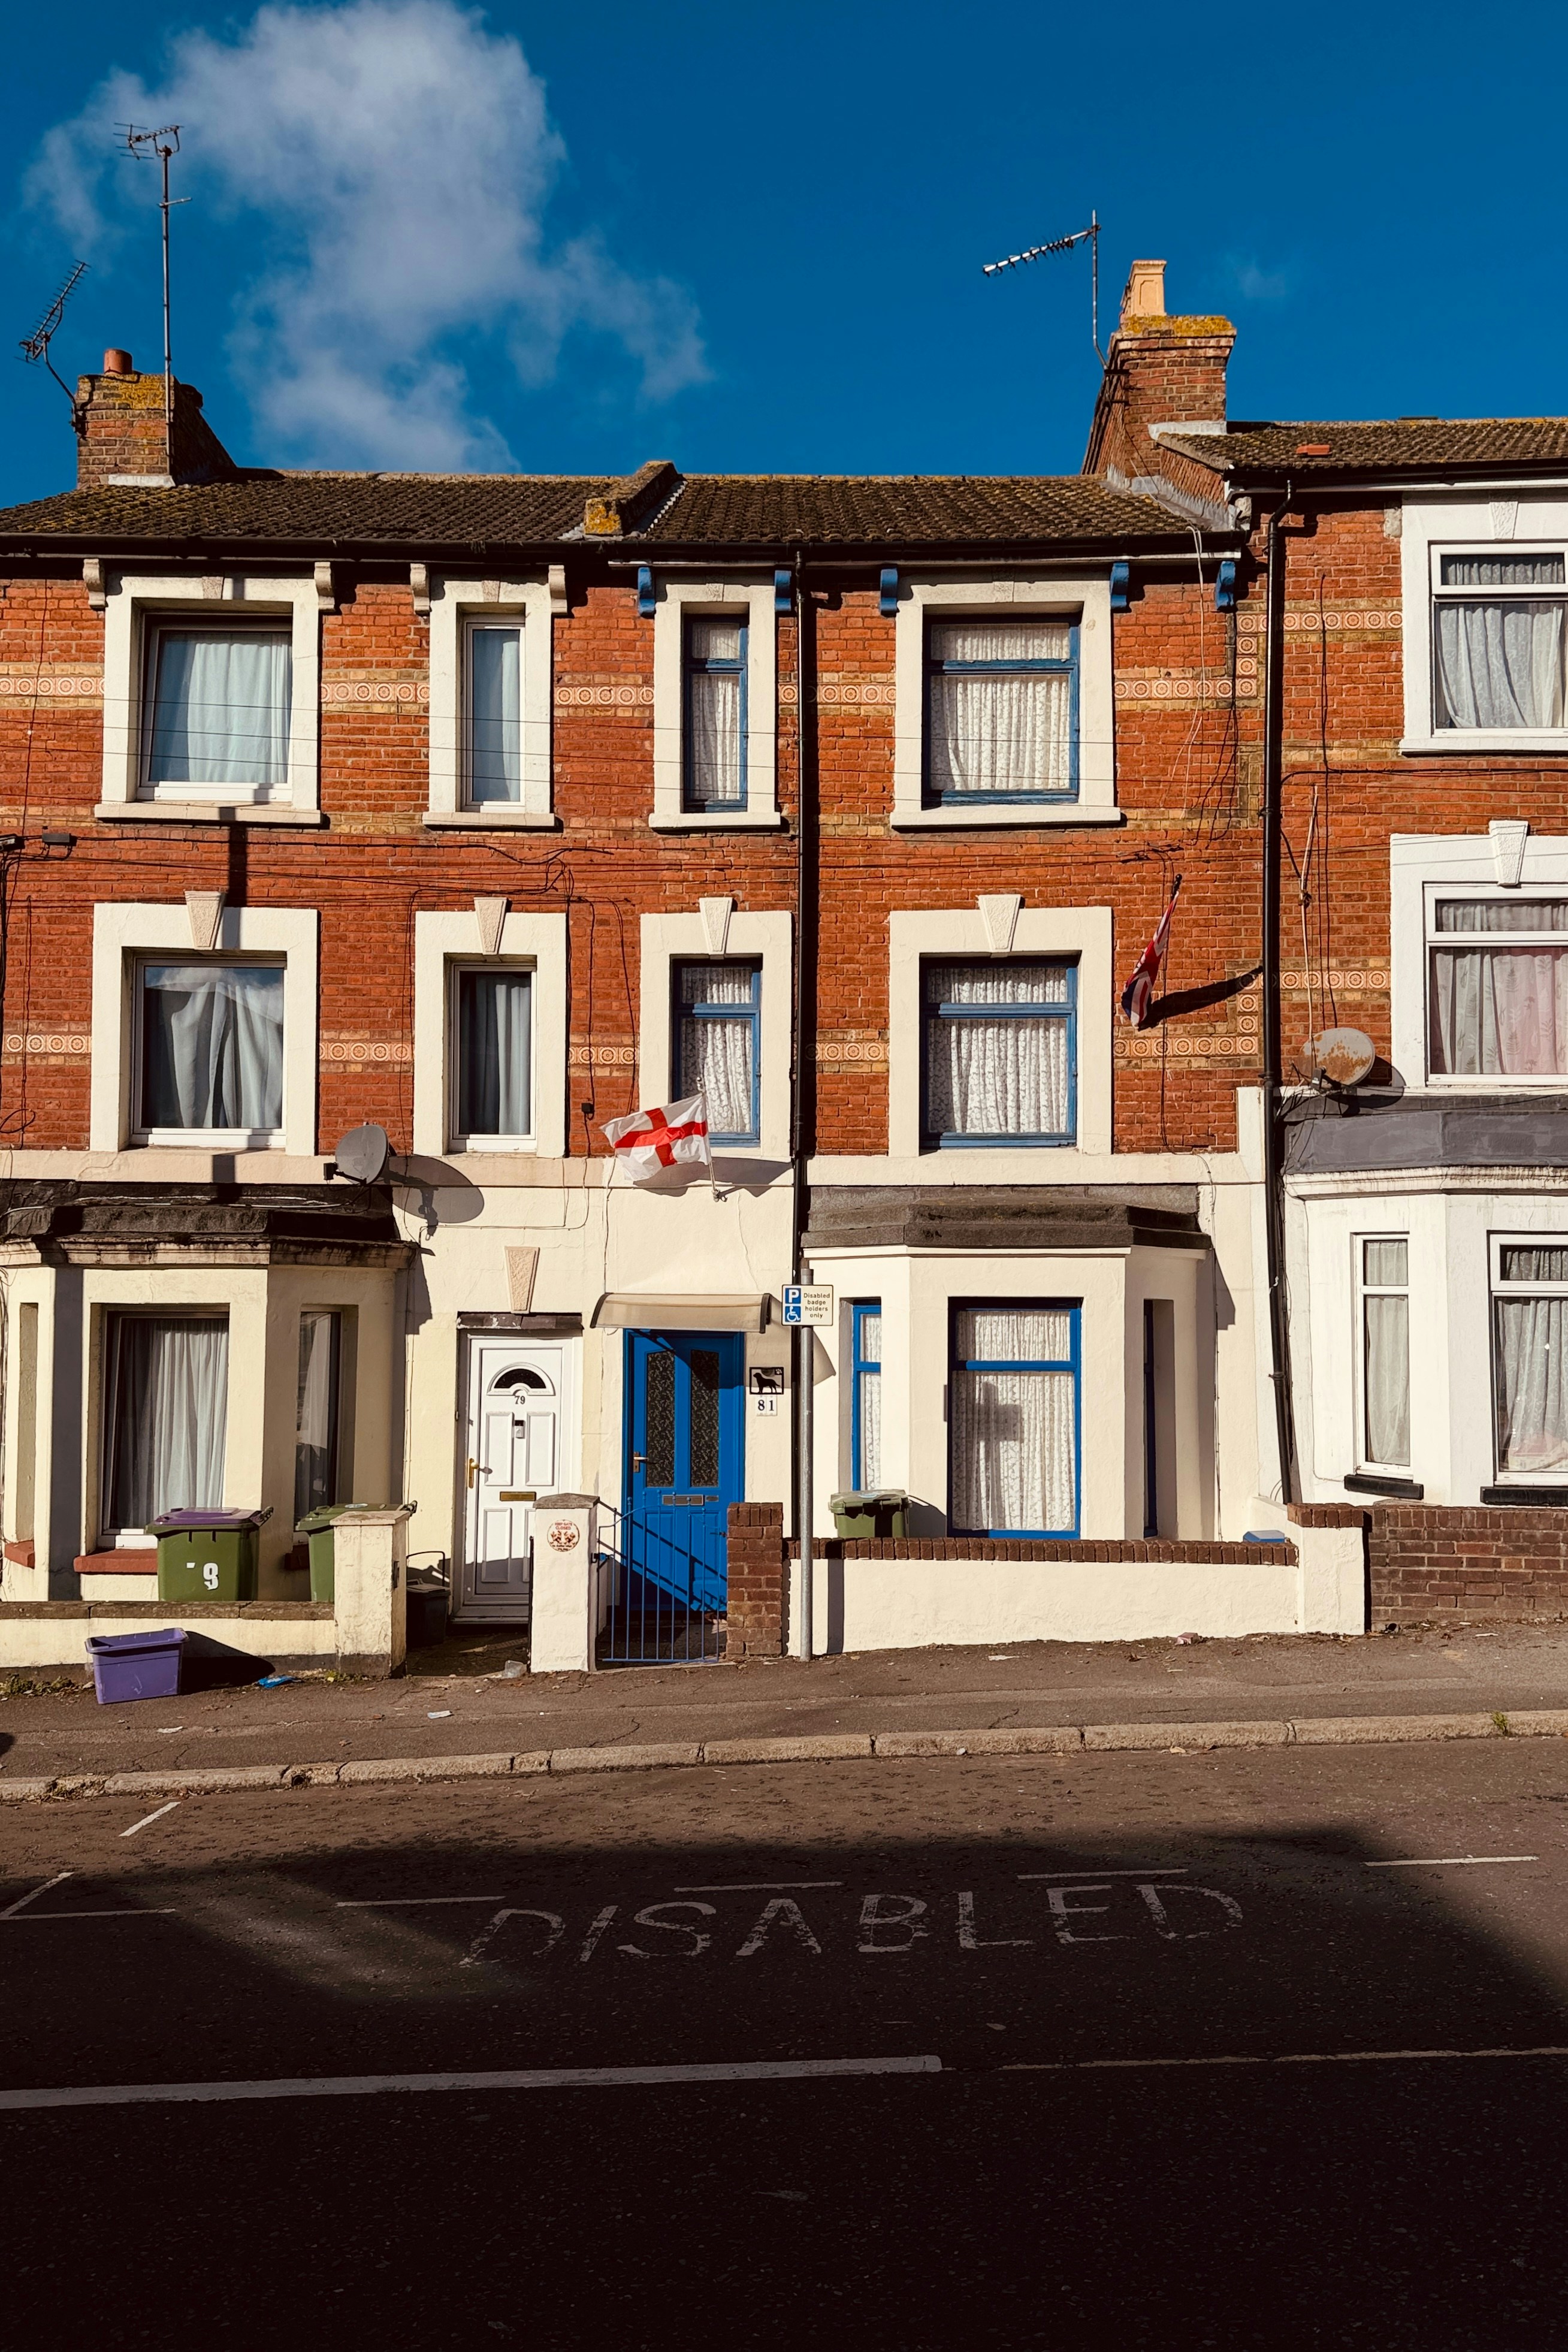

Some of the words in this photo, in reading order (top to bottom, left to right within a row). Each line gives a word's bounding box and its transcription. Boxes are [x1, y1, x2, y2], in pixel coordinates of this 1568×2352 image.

[788, 1289, 799, 1303] P
[515, 1396, 525, 1404] 79
[757, 1400, 774, 1411] 81
[458, 1883, 1244, 1967] DISABLED
